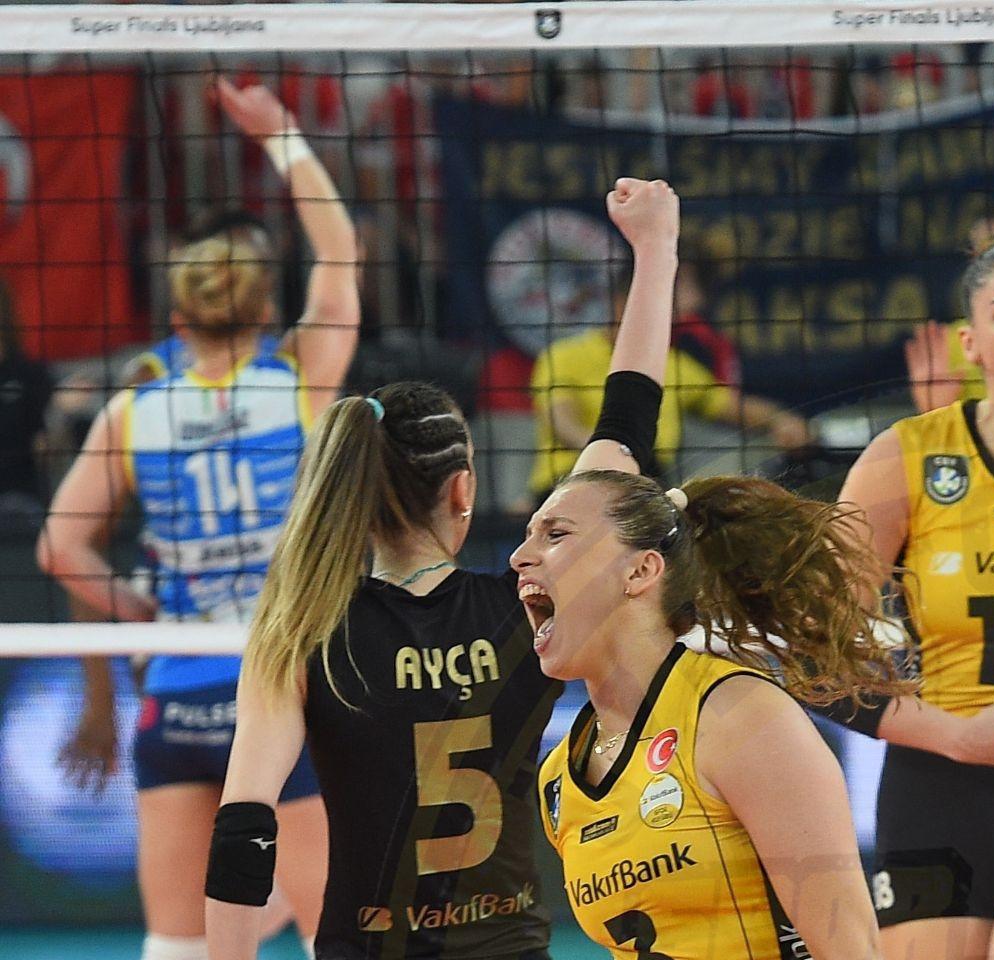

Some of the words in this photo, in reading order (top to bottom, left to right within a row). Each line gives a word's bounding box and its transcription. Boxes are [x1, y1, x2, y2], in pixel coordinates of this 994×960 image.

[70, 15, 122, 36] Super
[126, 15, 178, 32] Finals
[833, 9, 884, 28] Super
[889, 8, 940, 25] Finals
[184, 446, 260, 535] 14
[395, 638, 500, 701] AYÇA
[413, 714, 503, 876] 5
